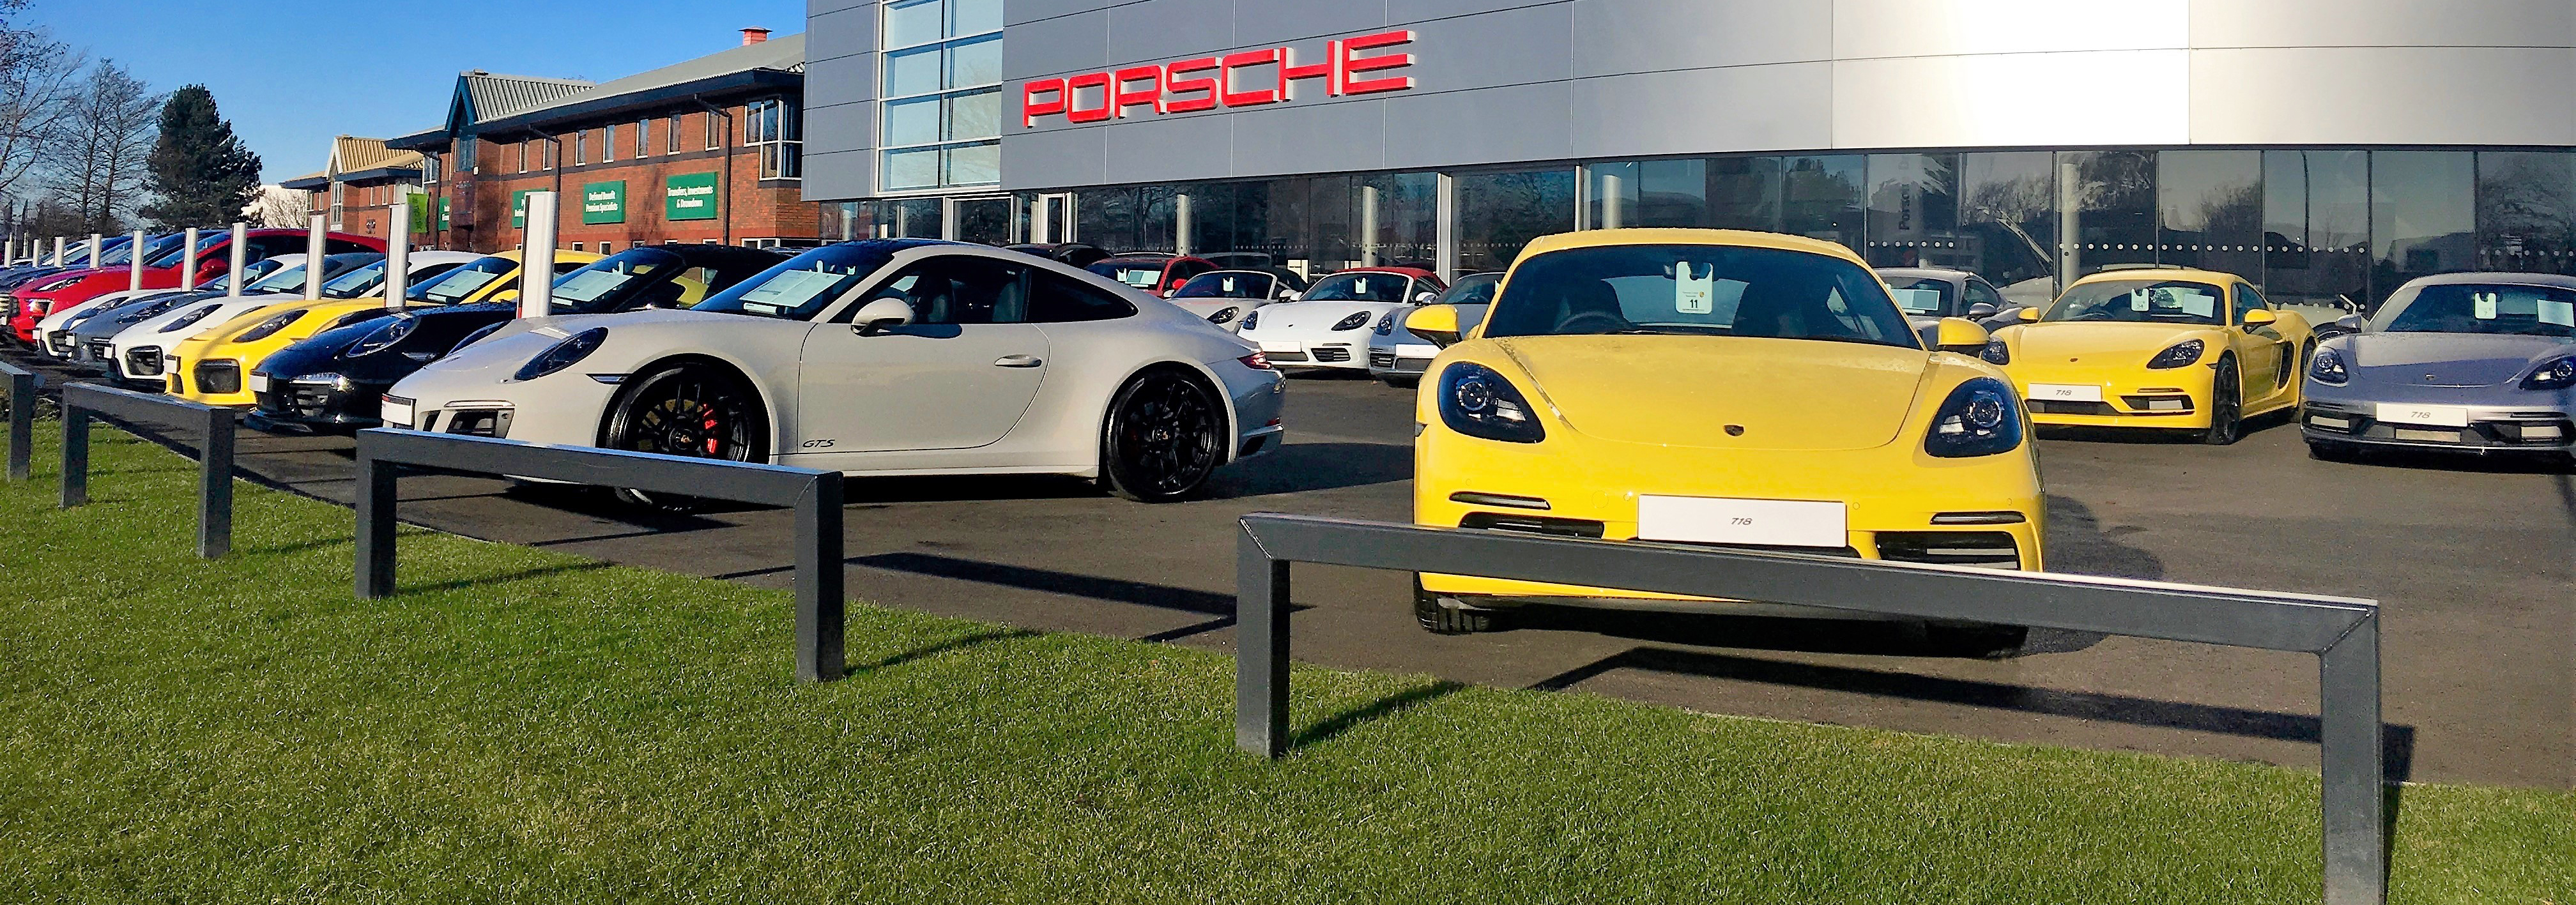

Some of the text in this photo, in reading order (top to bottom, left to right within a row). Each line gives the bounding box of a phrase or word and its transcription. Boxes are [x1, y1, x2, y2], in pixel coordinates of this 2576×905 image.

[1023, 31, 1416, 128] PORSCHE
[1689, 299, 1698, 308] 11
[802, 439, 835, 448] GTS
